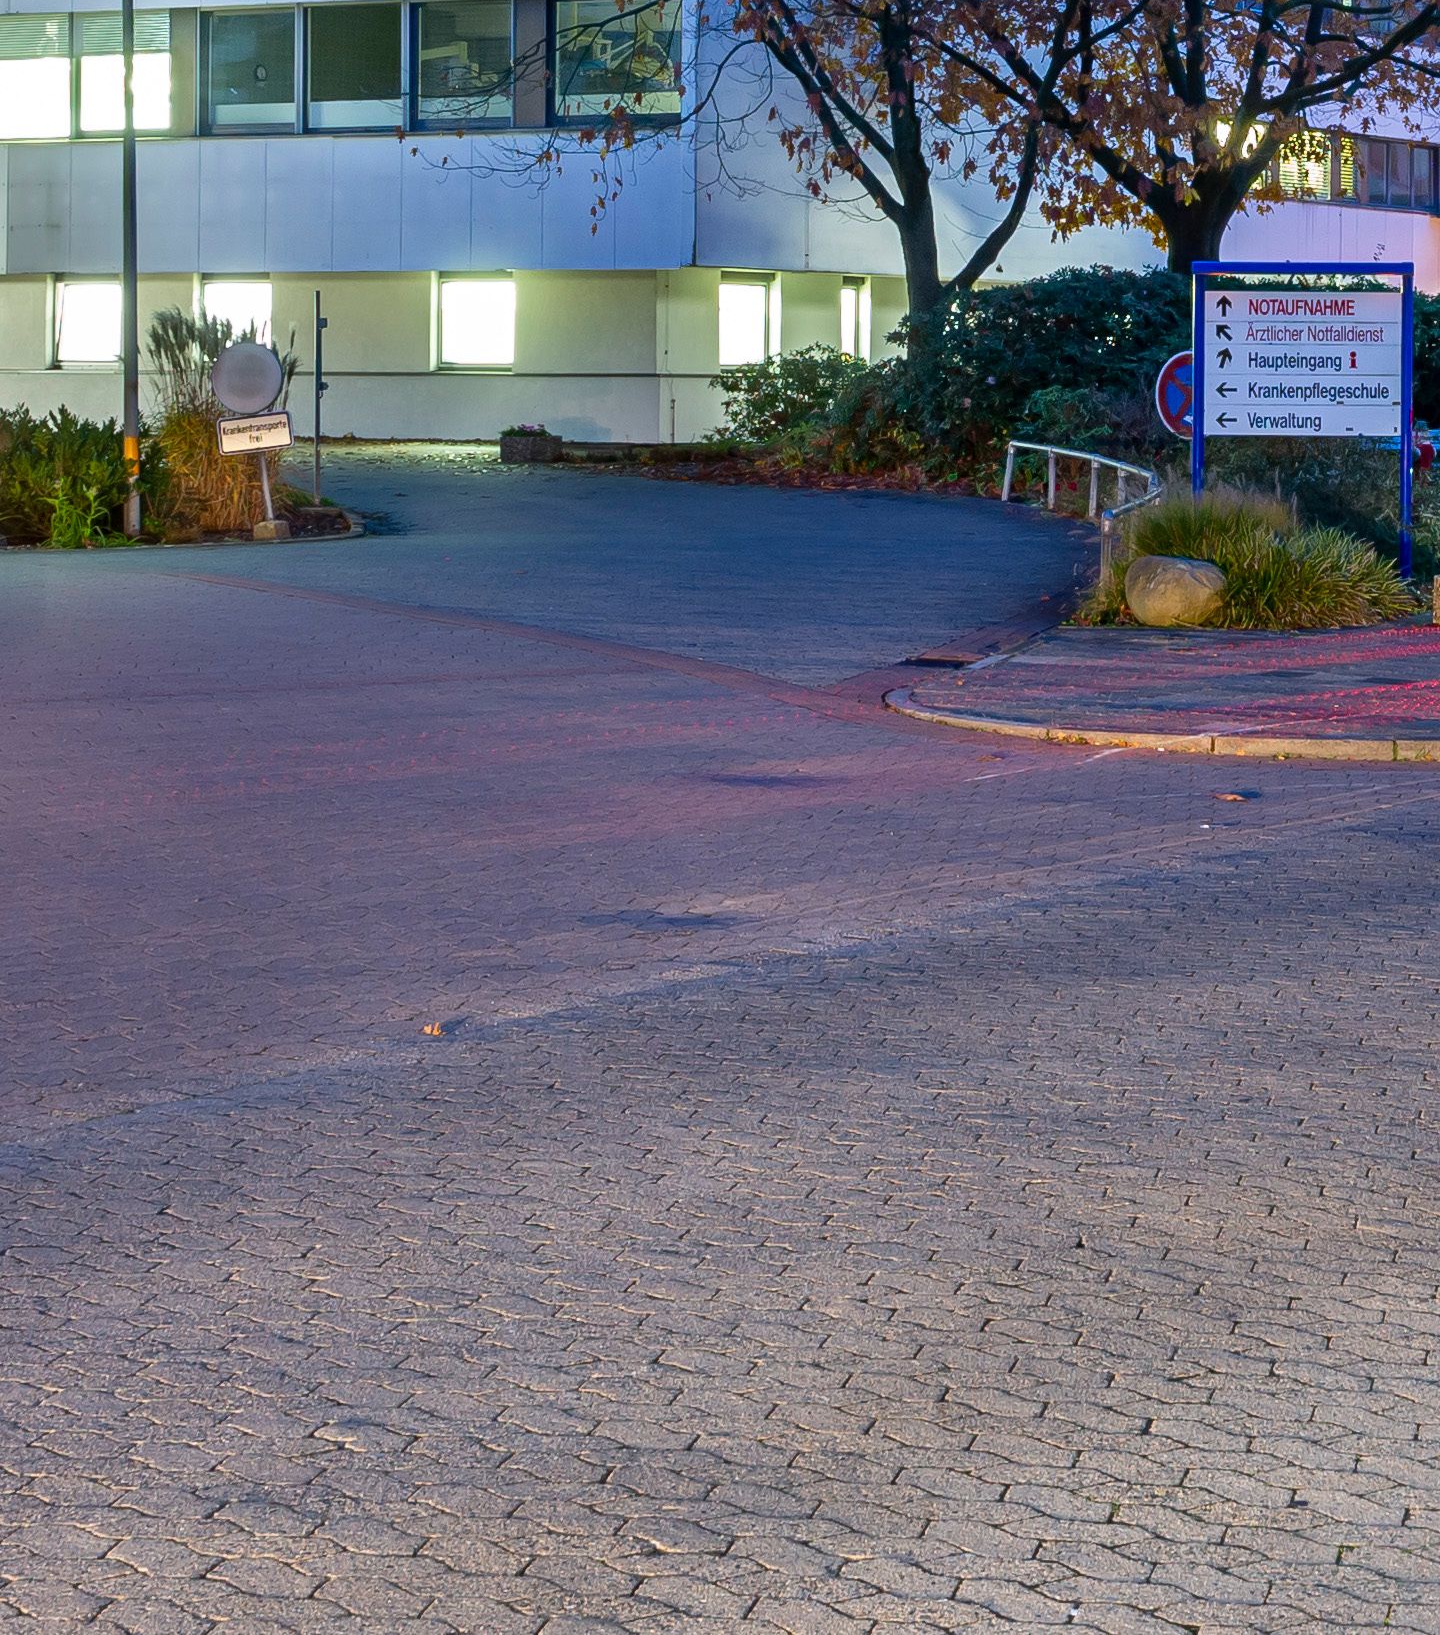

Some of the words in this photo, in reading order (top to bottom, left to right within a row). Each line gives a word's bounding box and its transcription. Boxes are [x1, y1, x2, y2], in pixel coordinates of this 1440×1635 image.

[1248, 299, 1356, 316] NOTAUFNAHME
[1245, 321, 1304, 342] Ärztlicher
[1307, 324, 1384, 343] Notfalldienst
[1248, 351, 1343, 372] Haupteingang
[1248, 381, 1390, 402] Krankenpflegeschule
[222, 420, 287, 435] Krankentransporte
[1246, 412, 1322, 432] Verwaltung
[249, 433, 263, 443] frei
